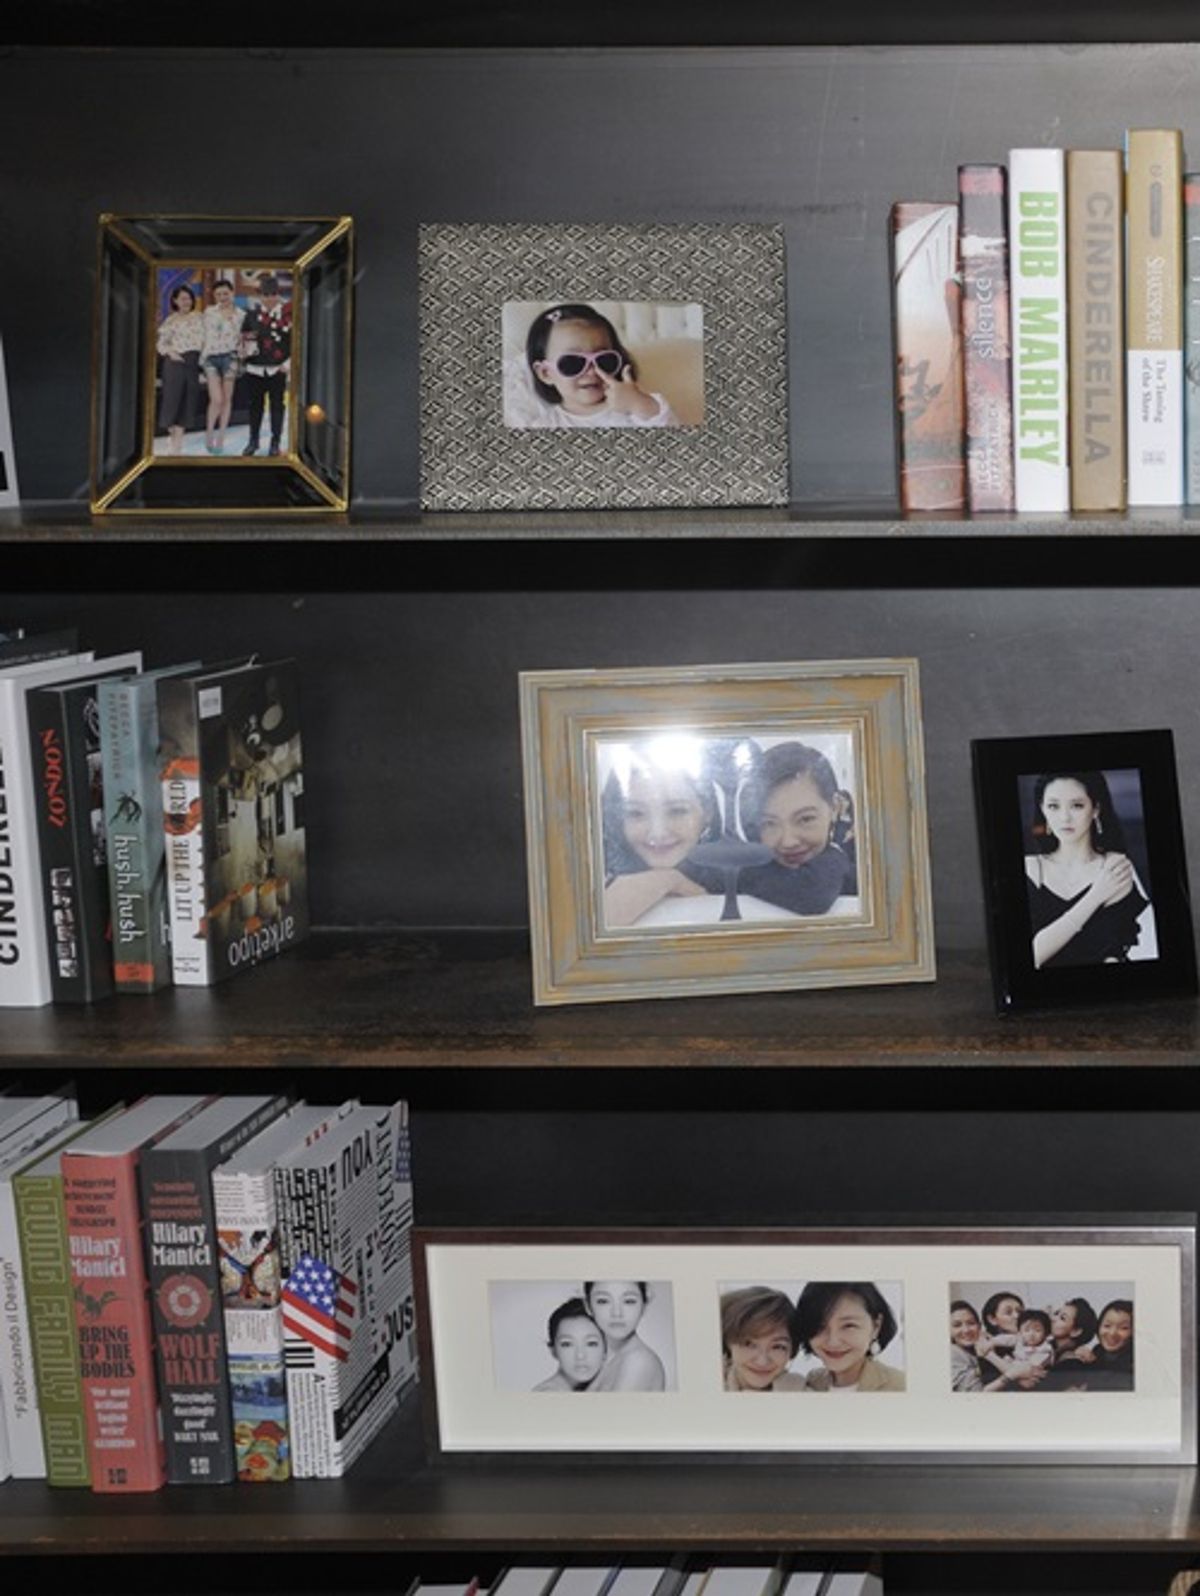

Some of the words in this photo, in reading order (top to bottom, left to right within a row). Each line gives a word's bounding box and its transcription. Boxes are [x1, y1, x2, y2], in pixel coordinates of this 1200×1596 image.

[1019, 191, 1059, 279] BOB
[976, 276, 994, 359] silence
[1083, 190, 1115, 466] CINDERELLA
[1019, 297, 1060, 466] MARLEY
[39, 728, 67, 828] LONDON
[172, 839, 190, 873] THE
[152, 1221, 207, 1246] Hilary
[151, 1244, 212, 1266] Mantel
[32, 1296, 80, 1402] FAMILY
[79, 1326, 128, 1342] BRING
[158, 1332, 220, 1360] WOLF
[79, 1343, 99, 1360] UP
[102, 1343, 131, 1360] THE
[80, 1361, 136, 1378] BODIES
[164, 1359, 221, 1385] HALL
[46, 1413, 88, 1481] MAN
